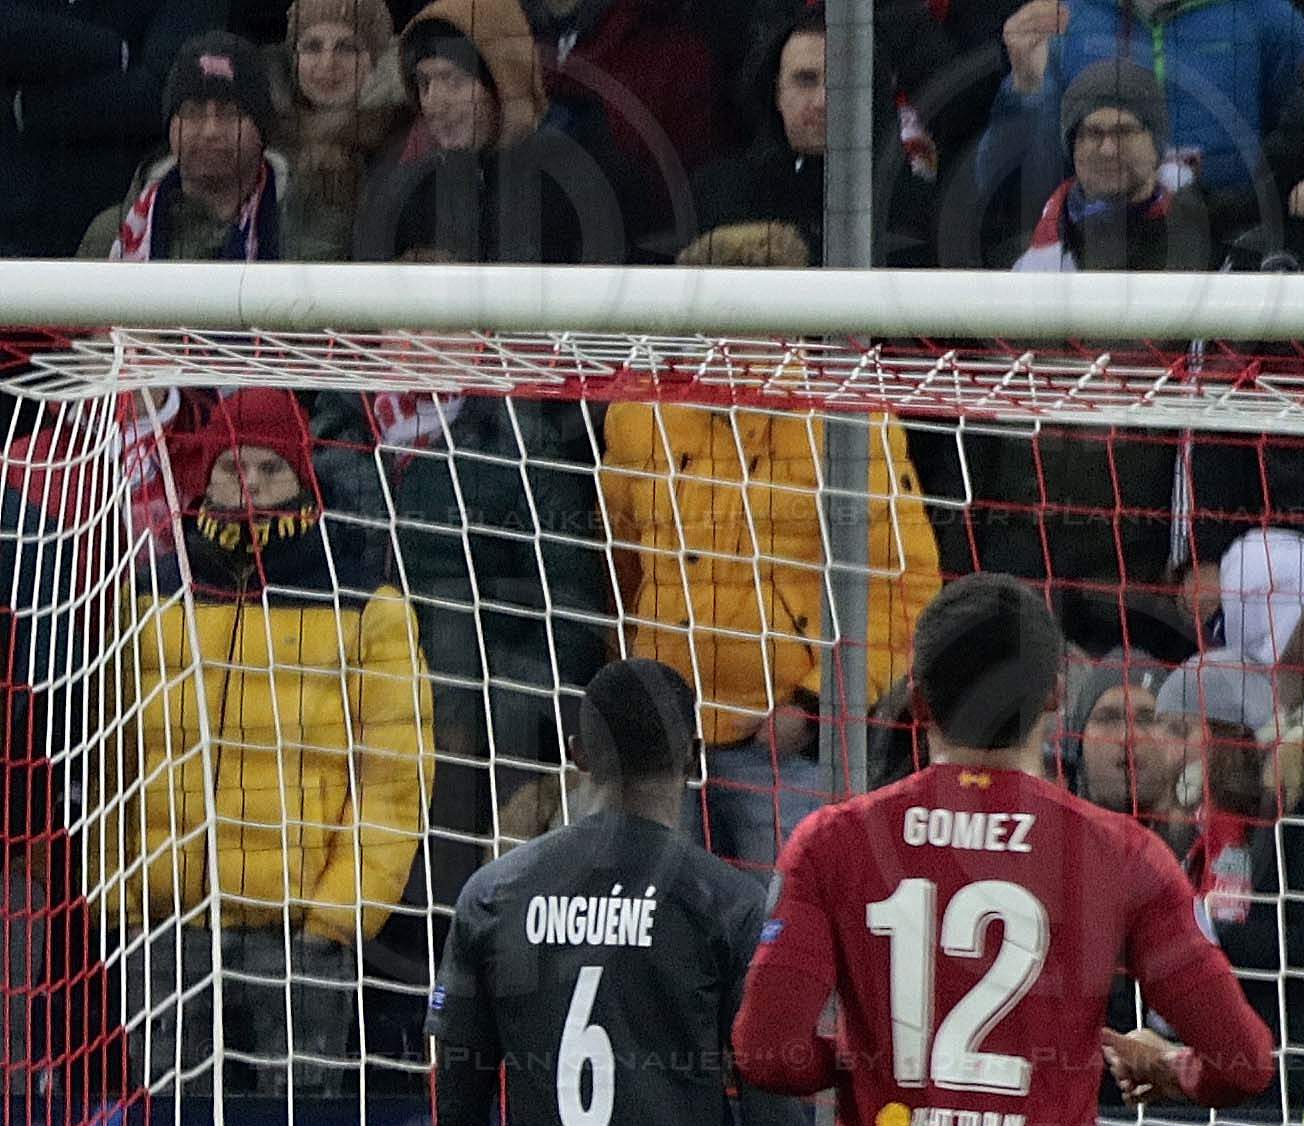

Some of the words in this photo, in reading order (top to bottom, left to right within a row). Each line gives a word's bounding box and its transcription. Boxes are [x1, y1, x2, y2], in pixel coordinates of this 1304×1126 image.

[903, 806, 1036, 853] GOMEZ
[526, 884, 656, 947] ONGUÉNÉ
[865, 877, 1050, 1096] 12
